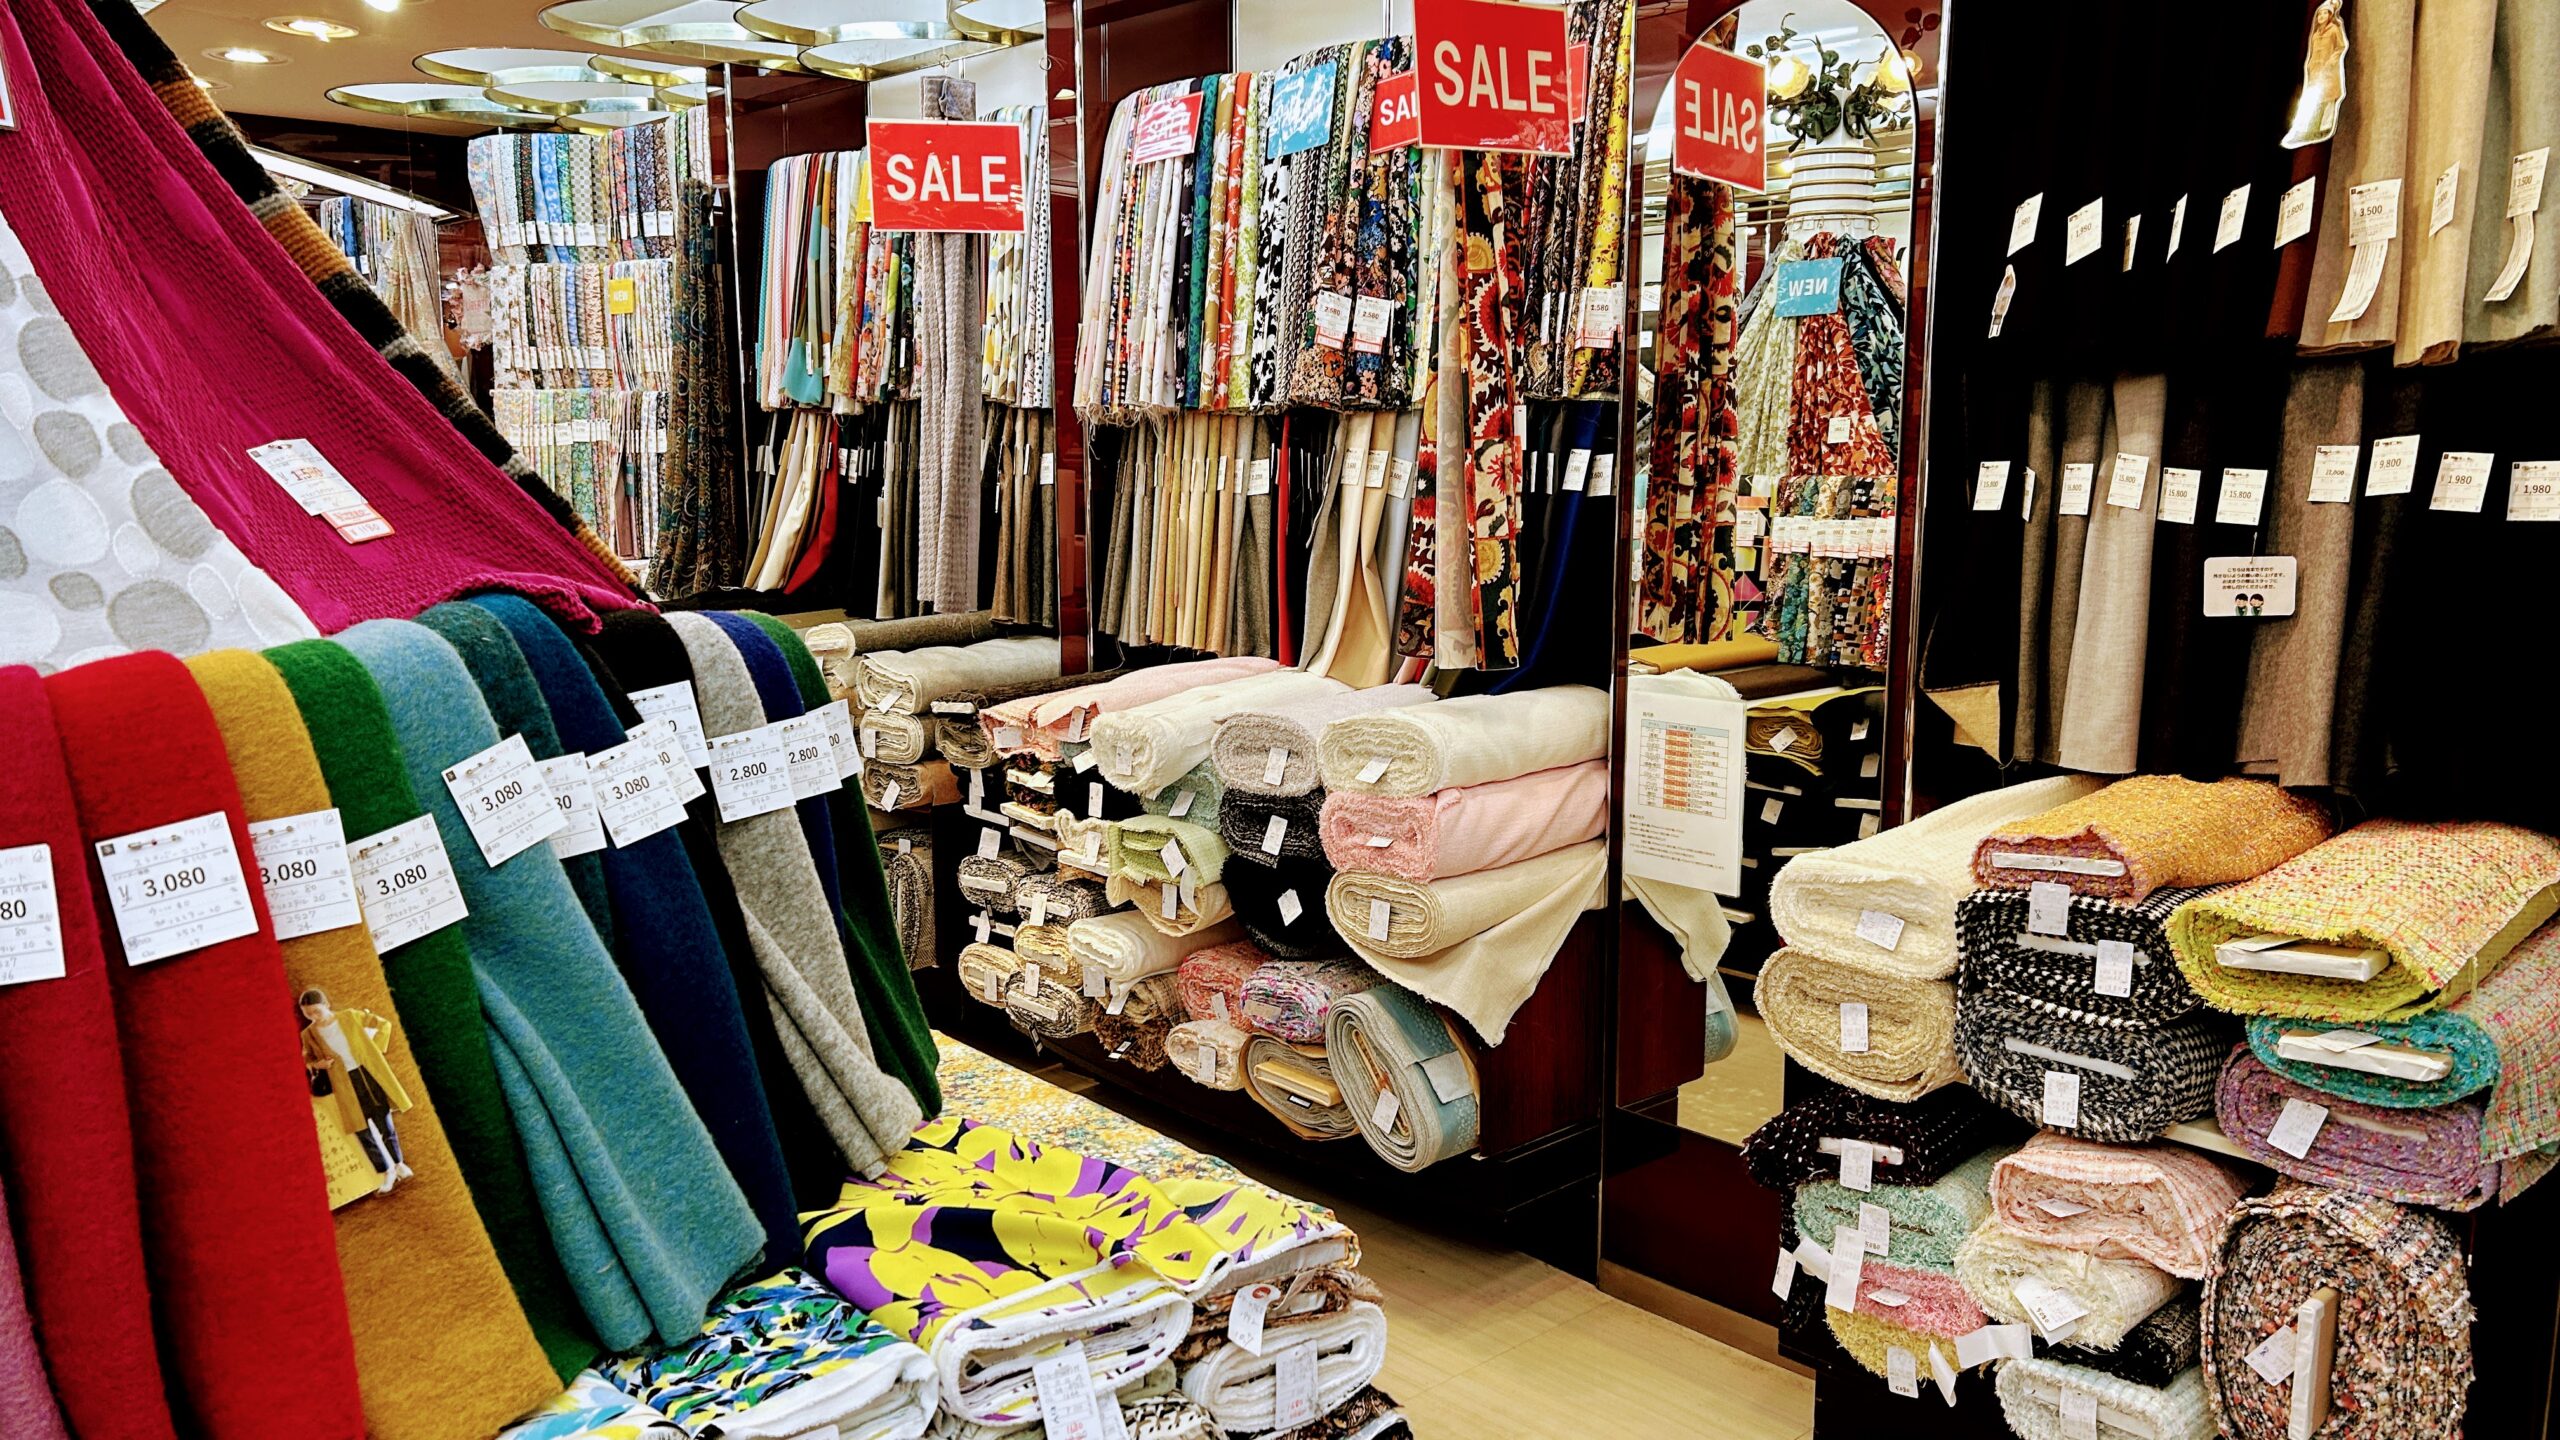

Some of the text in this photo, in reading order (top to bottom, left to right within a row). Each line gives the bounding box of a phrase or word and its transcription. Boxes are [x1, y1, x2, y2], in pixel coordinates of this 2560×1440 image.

[1433, 40, 1555, 114] SALE
[886, 153, 1009, 202] SALE
[481, 780, 523, 812] 3,080
[612, 775, 650, 800] 3,080
[142, 866, 207, 898] 3,080
[377, 864, 427, 896] 3,080
